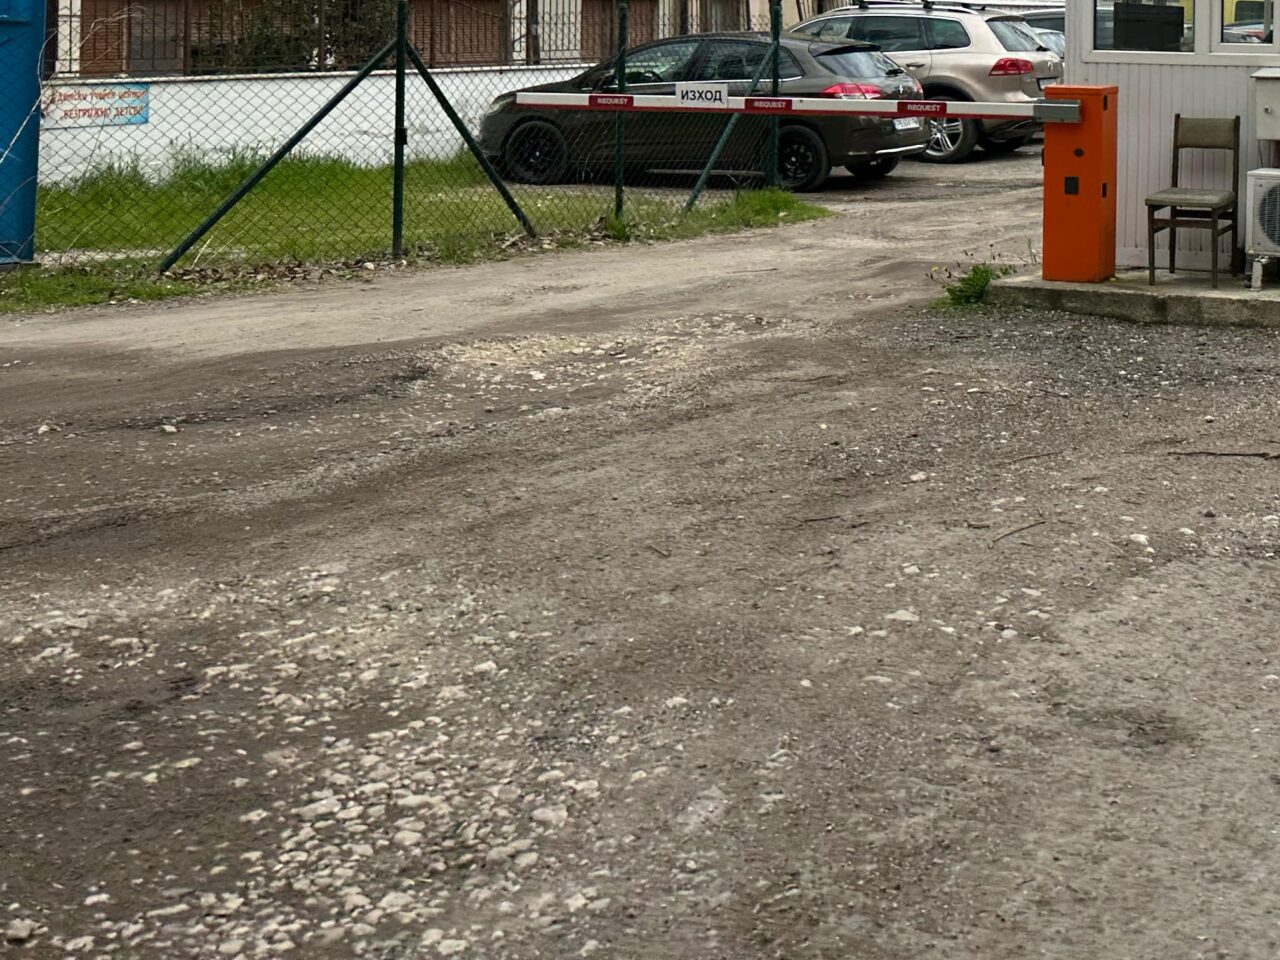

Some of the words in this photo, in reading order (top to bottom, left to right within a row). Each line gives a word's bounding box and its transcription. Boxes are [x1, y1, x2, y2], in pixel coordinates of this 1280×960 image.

[681, 89, 722, 103] ИЗХОД
[597, 97, 629, 105] REQUEST
[753, 100, 787, 108] REQUEST
[907, 103, 941, 112] REQUEST
